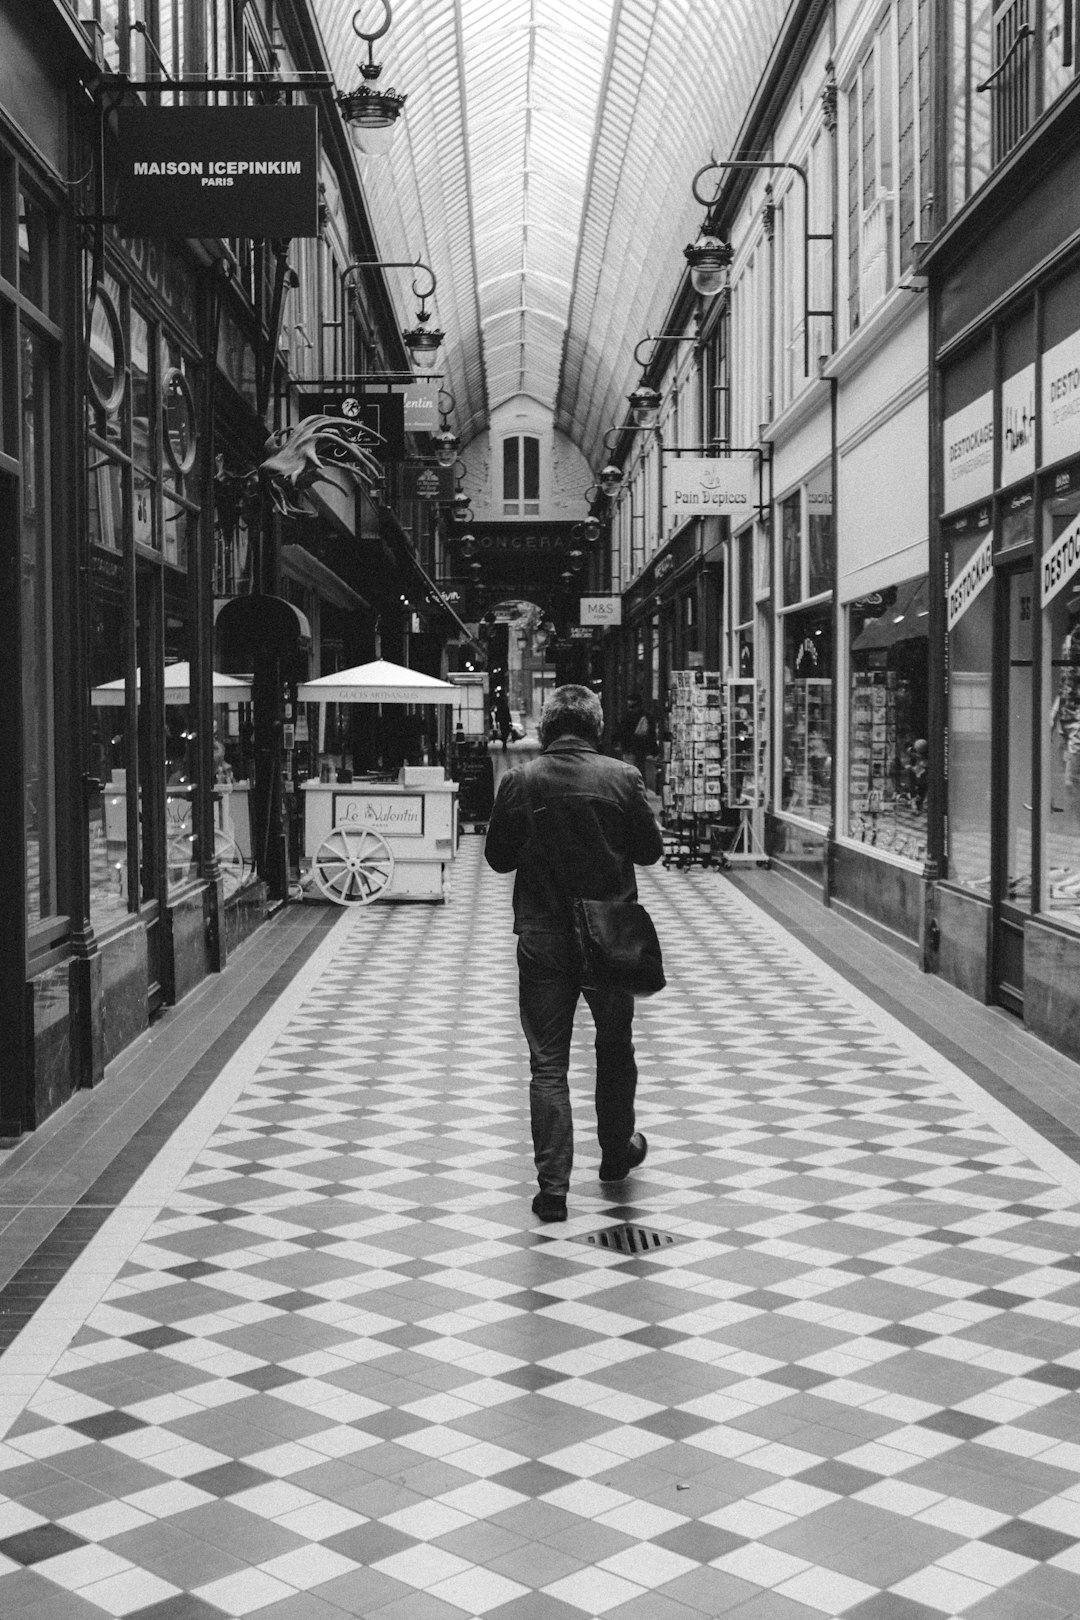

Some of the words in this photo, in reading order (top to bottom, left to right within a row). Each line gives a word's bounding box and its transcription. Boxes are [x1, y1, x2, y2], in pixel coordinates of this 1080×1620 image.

[134, 162, 203, 175] MAISON
[208, 161, 301, 175] ICEPINKIM
[201, 177, 234, 187] PARIS
[949, 421, 993, 462] DESTOCKAGE
[674, 490, 699, 504] Pain
[950, 541, 993, 620] DESTOCKAG
[588, 603, 614, 614] M&S
[339, 802, 359, 822] Le
[367, 802, 418, 822] Valentin
